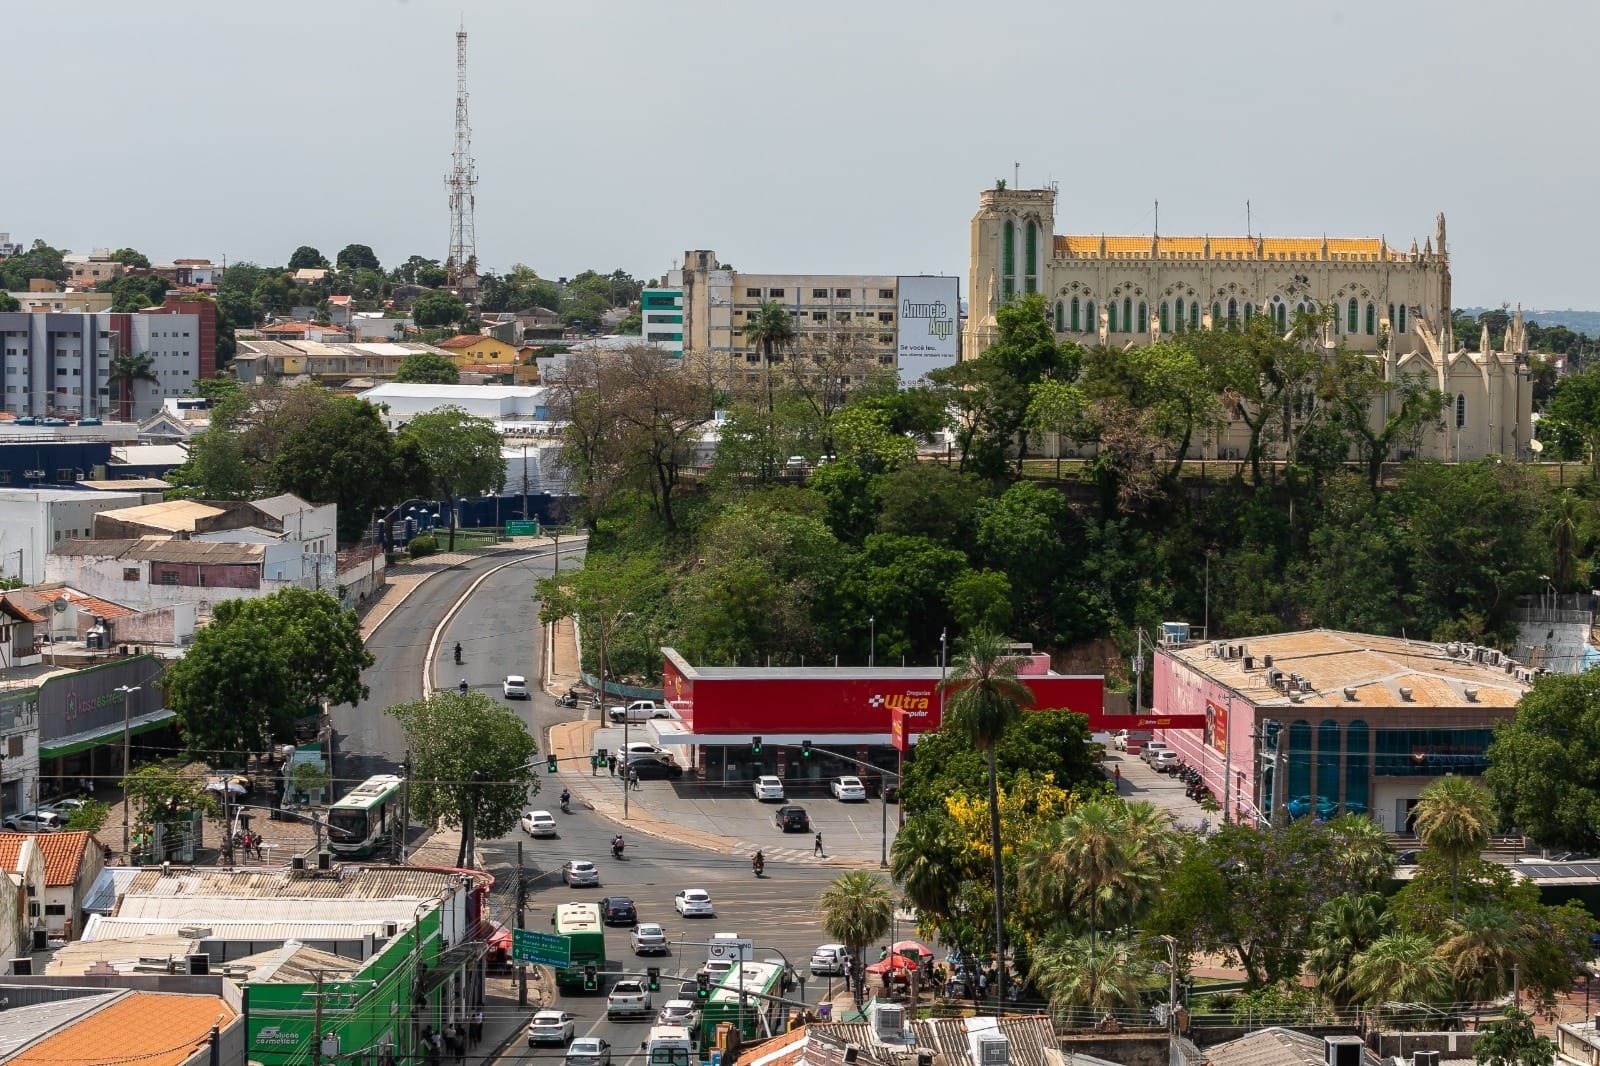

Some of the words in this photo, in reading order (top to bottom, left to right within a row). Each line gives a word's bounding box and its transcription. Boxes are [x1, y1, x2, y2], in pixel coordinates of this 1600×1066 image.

[902, 299, 946, 318] Anuncie
[928, 318, 953, 340] Aqui
[884, 694, 929, 709] Ultra
